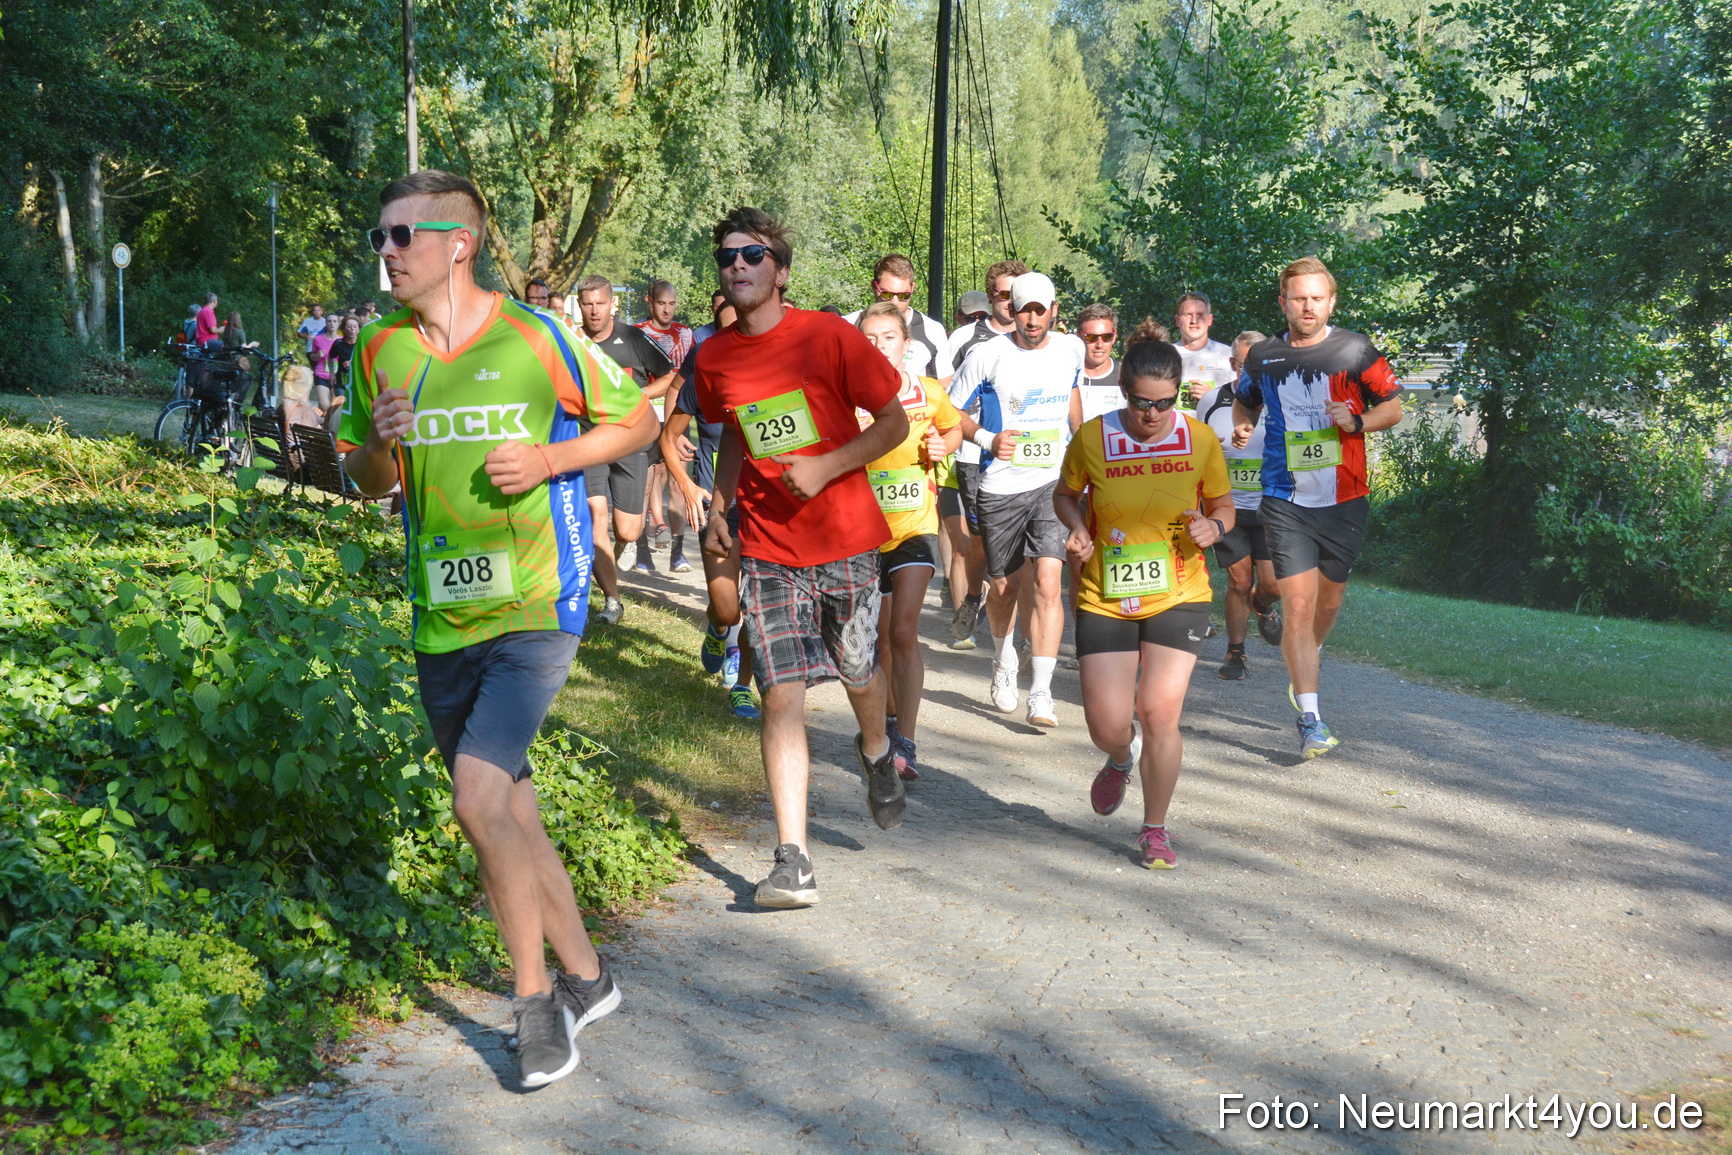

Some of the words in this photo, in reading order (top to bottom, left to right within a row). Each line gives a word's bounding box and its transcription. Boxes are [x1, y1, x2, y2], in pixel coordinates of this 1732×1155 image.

[1289, 403, 1323, 411] AUTOHAUS
[906, 411, 929, 423] ÖGL
[755, 415, 796, 442] 239
[779, 435, 799, 443] Sascha
[1023, 443, 1051, 457] 633
[1302, 444, 1323, 459] 48
[1105, 464, 1145, 479] MAX
[1151, 459, 1194, 475] BÖGL
[876, 482, 919, 500] 1346
[440, 556, 493, 587] 208
[1110, 561, 1161, 582] 1218
[447, 587, 468, 595] Vörös
[469, 584, 493, 592] Laszlo
